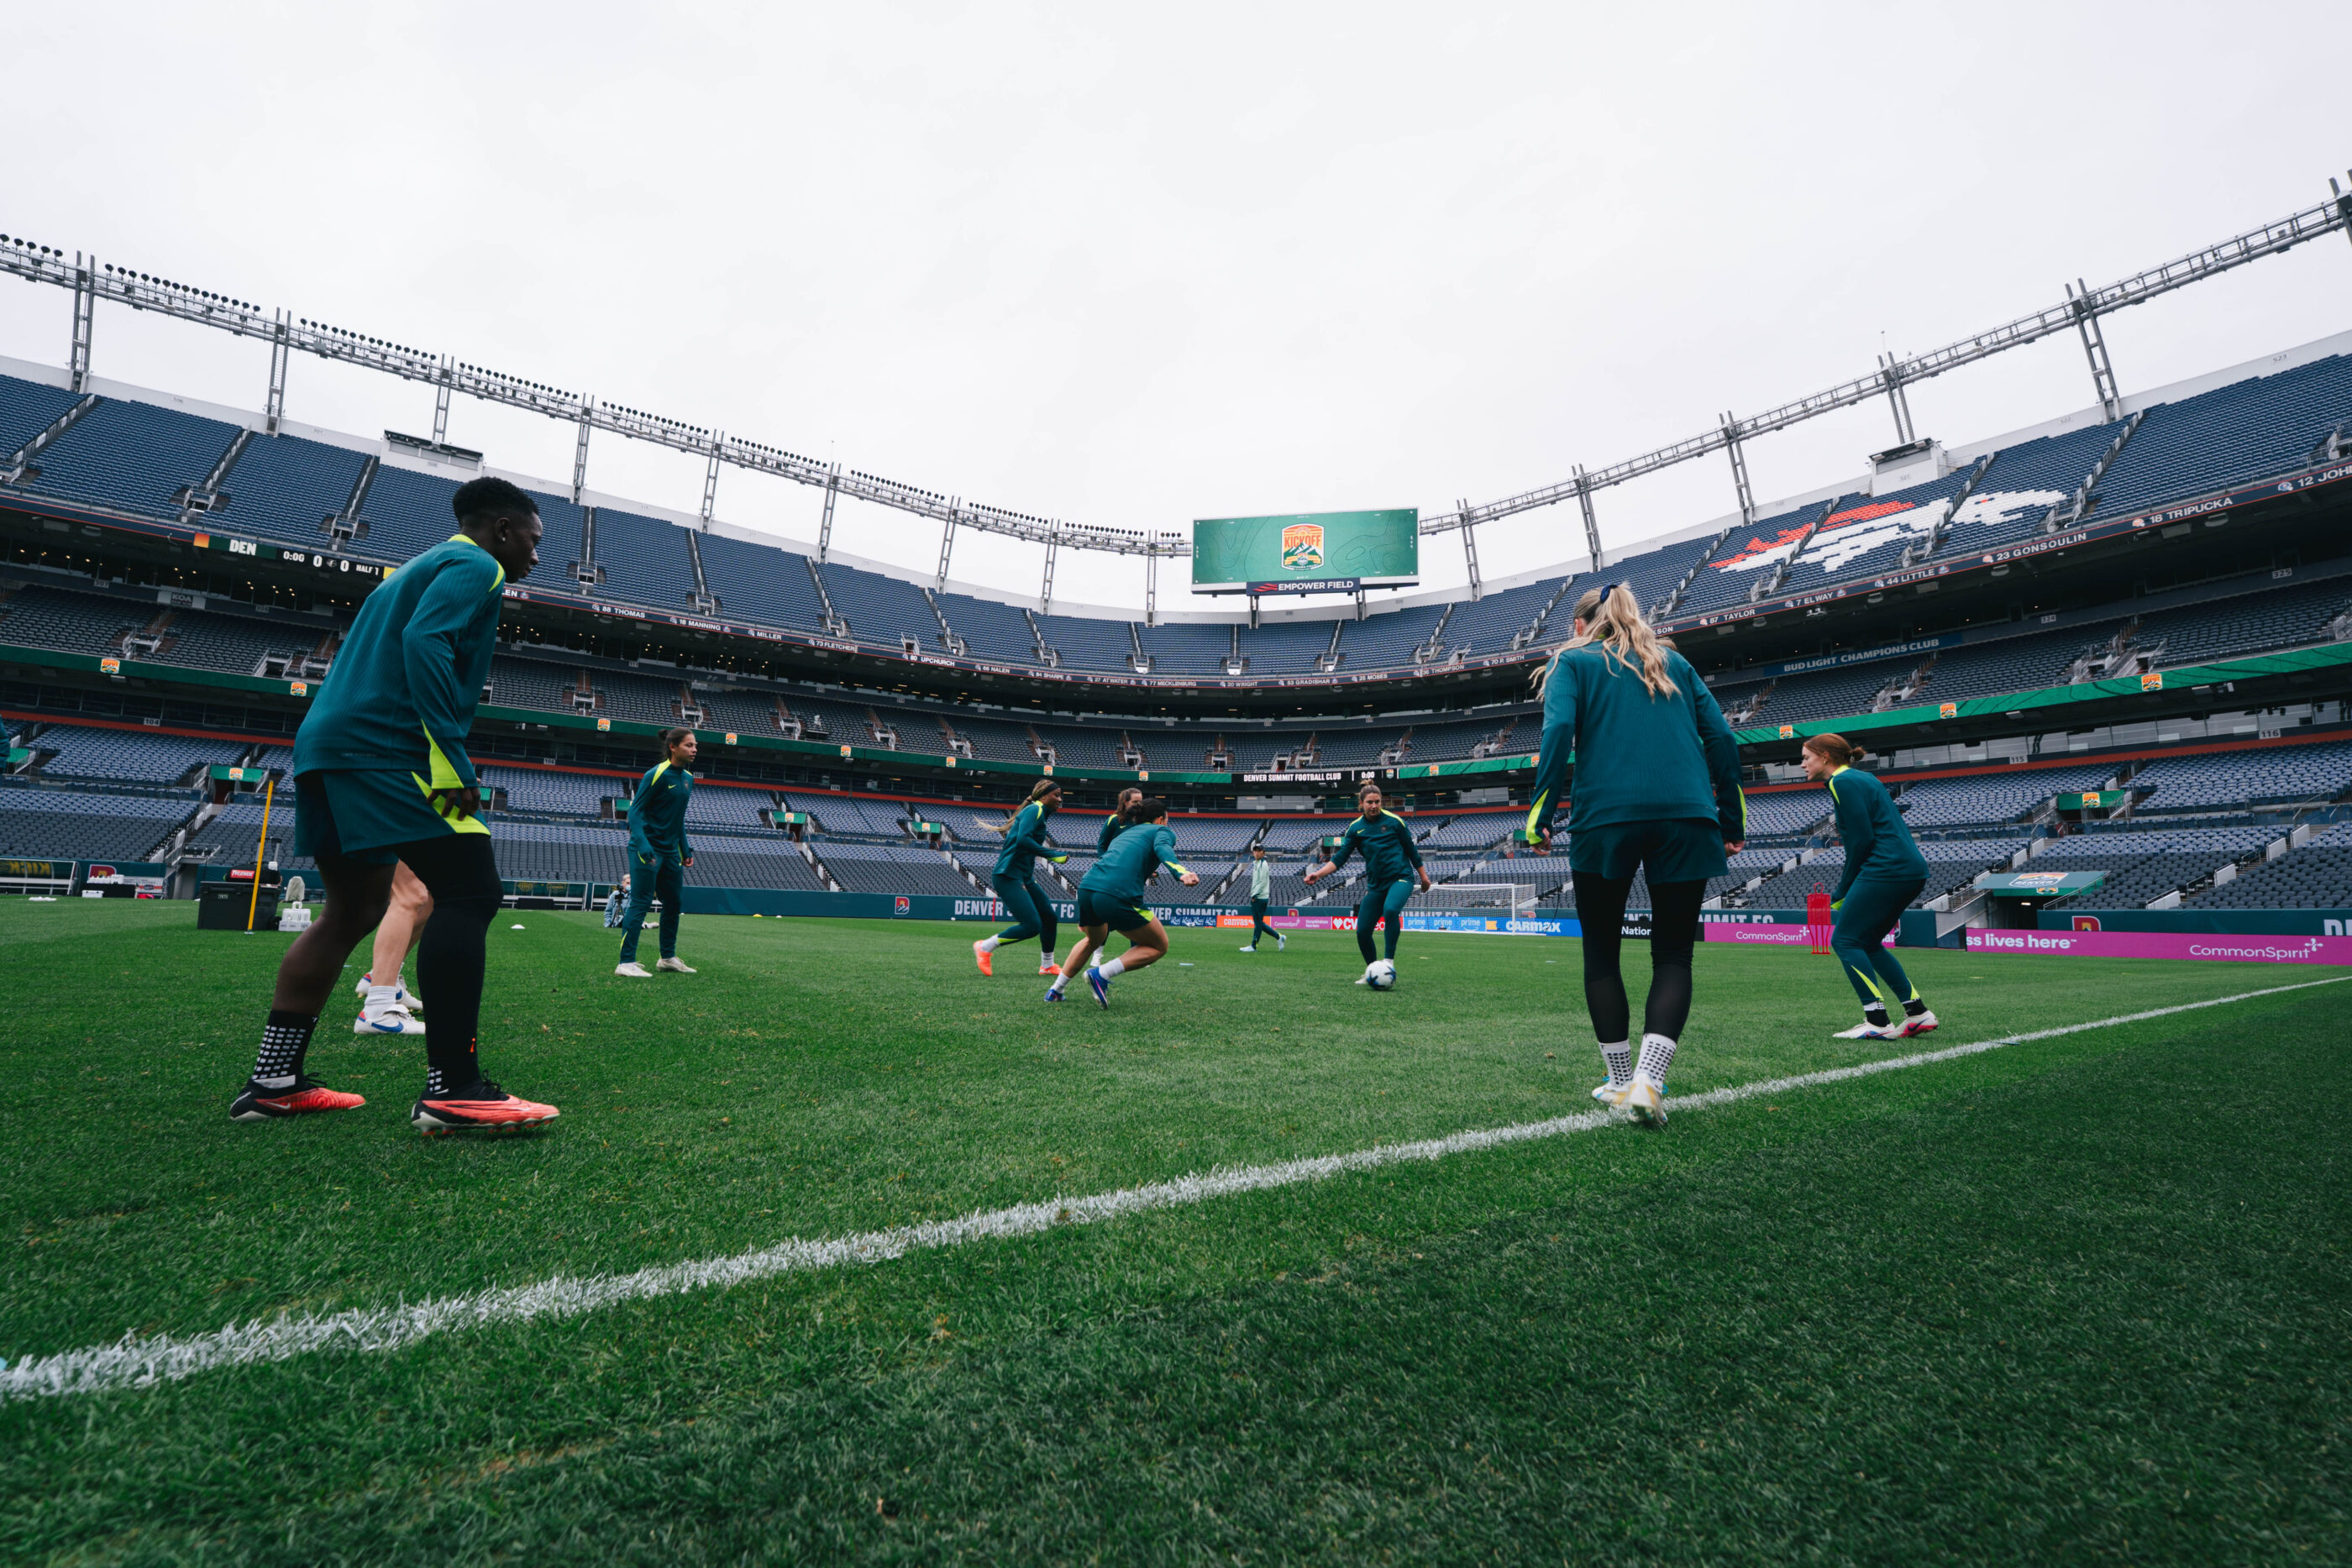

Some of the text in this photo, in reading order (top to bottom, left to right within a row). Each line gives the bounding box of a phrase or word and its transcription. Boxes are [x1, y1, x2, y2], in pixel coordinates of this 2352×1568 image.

[2298, 478, 2314, 488] 12
[2149, 496, 2234, 524] 18 TRIPUCKA
[1997, 532, 2088, 562] 23 GONSOULIN
[228, 539, 256, 556] DEN
[313, 554, 323, 568] 0
[340, 559, 349, 573] 0
[356, 564, 373, 574] HALF
[1887, 568, 1935, 585] 44 LITTLE
[2273, 569, 2291, 578] 325
[1278, 580, 1354, 592] EMPOWER FIELD
[172, 593, 192, 603] KOA
[1796, 591, 1834, 606] 7 ELWAY
[602, 606, 645, 618] 88 THOMAS
[1709, 609, 1756, 625] 87 TAYLOR
[689, 621, 721, 632] MANNING
[757, 631, 782, 641] MILLER
[824, 642, 855, 652] FLETCHER
[921, 656, 955, 667] UPCHURCH
[1506, 654, 1525, 663] SMITH
[1784, 639, 1940, 673] BUD LIGHT CHAMPIONS CLUB
[1431, 664, 1465, 674] THOMPSON
[2260, 729, 2279, 739] 116
[1243, 772, 1341, 783] DENVER SUMMIT FOOTBALL CLUB
[954, 899, 1004, 916] DENVER
[1060, 903, 1075, 919] FC
[1223, 918, 1248, 926] canvas
[1408, 919, 1426, 927] prime
[1433, 919, 1452, 927] prime
[1461, 919, 1482, 927] prime
[1735, 931, 1803, 943] CommonSpirit
[1985, 933, 2024, 947] lives
[2189, 944, 2310, 961] CommonSpirit
